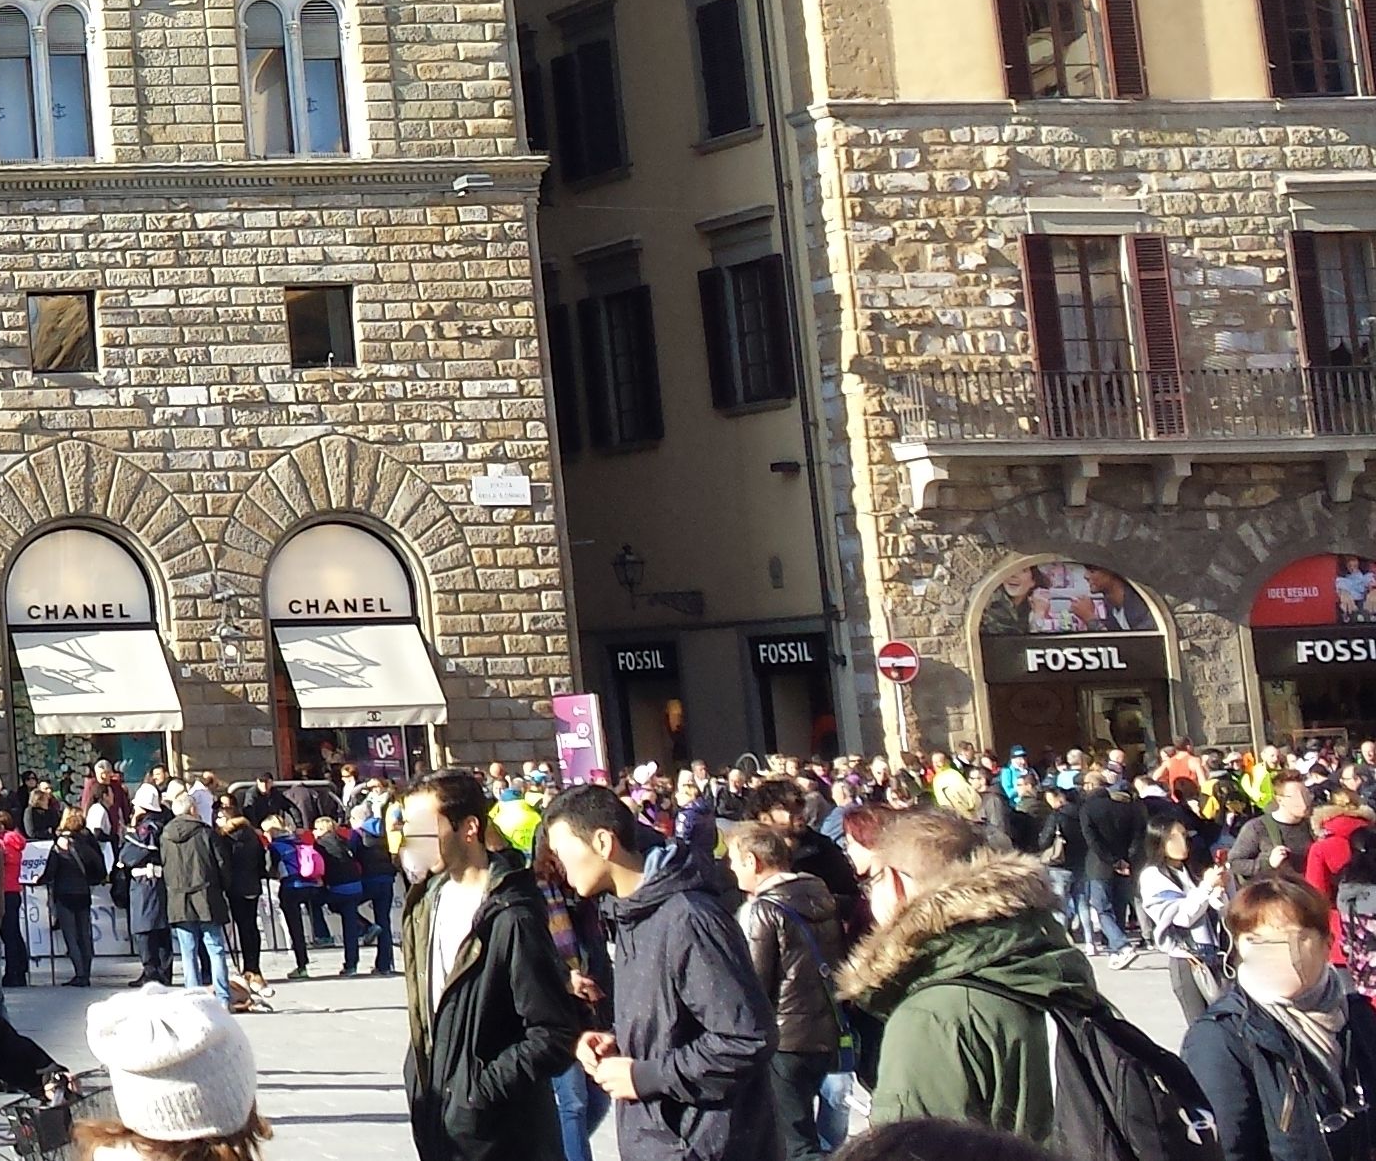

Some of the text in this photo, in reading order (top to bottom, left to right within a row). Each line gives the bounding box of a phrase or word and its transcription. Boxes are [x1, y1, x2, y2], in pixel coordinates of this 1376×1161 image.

[1267, 586, 1319, 599] IDEE REGALO
[27, 603, 131, 620] CHANEL
[288, 597, 392, 614] CHANEL
[617, 649, 665, 671] FOSSIL
[758, 641, 813, 664] FOSSIL
[1025, 646, 1128, 672] FOSSIL
